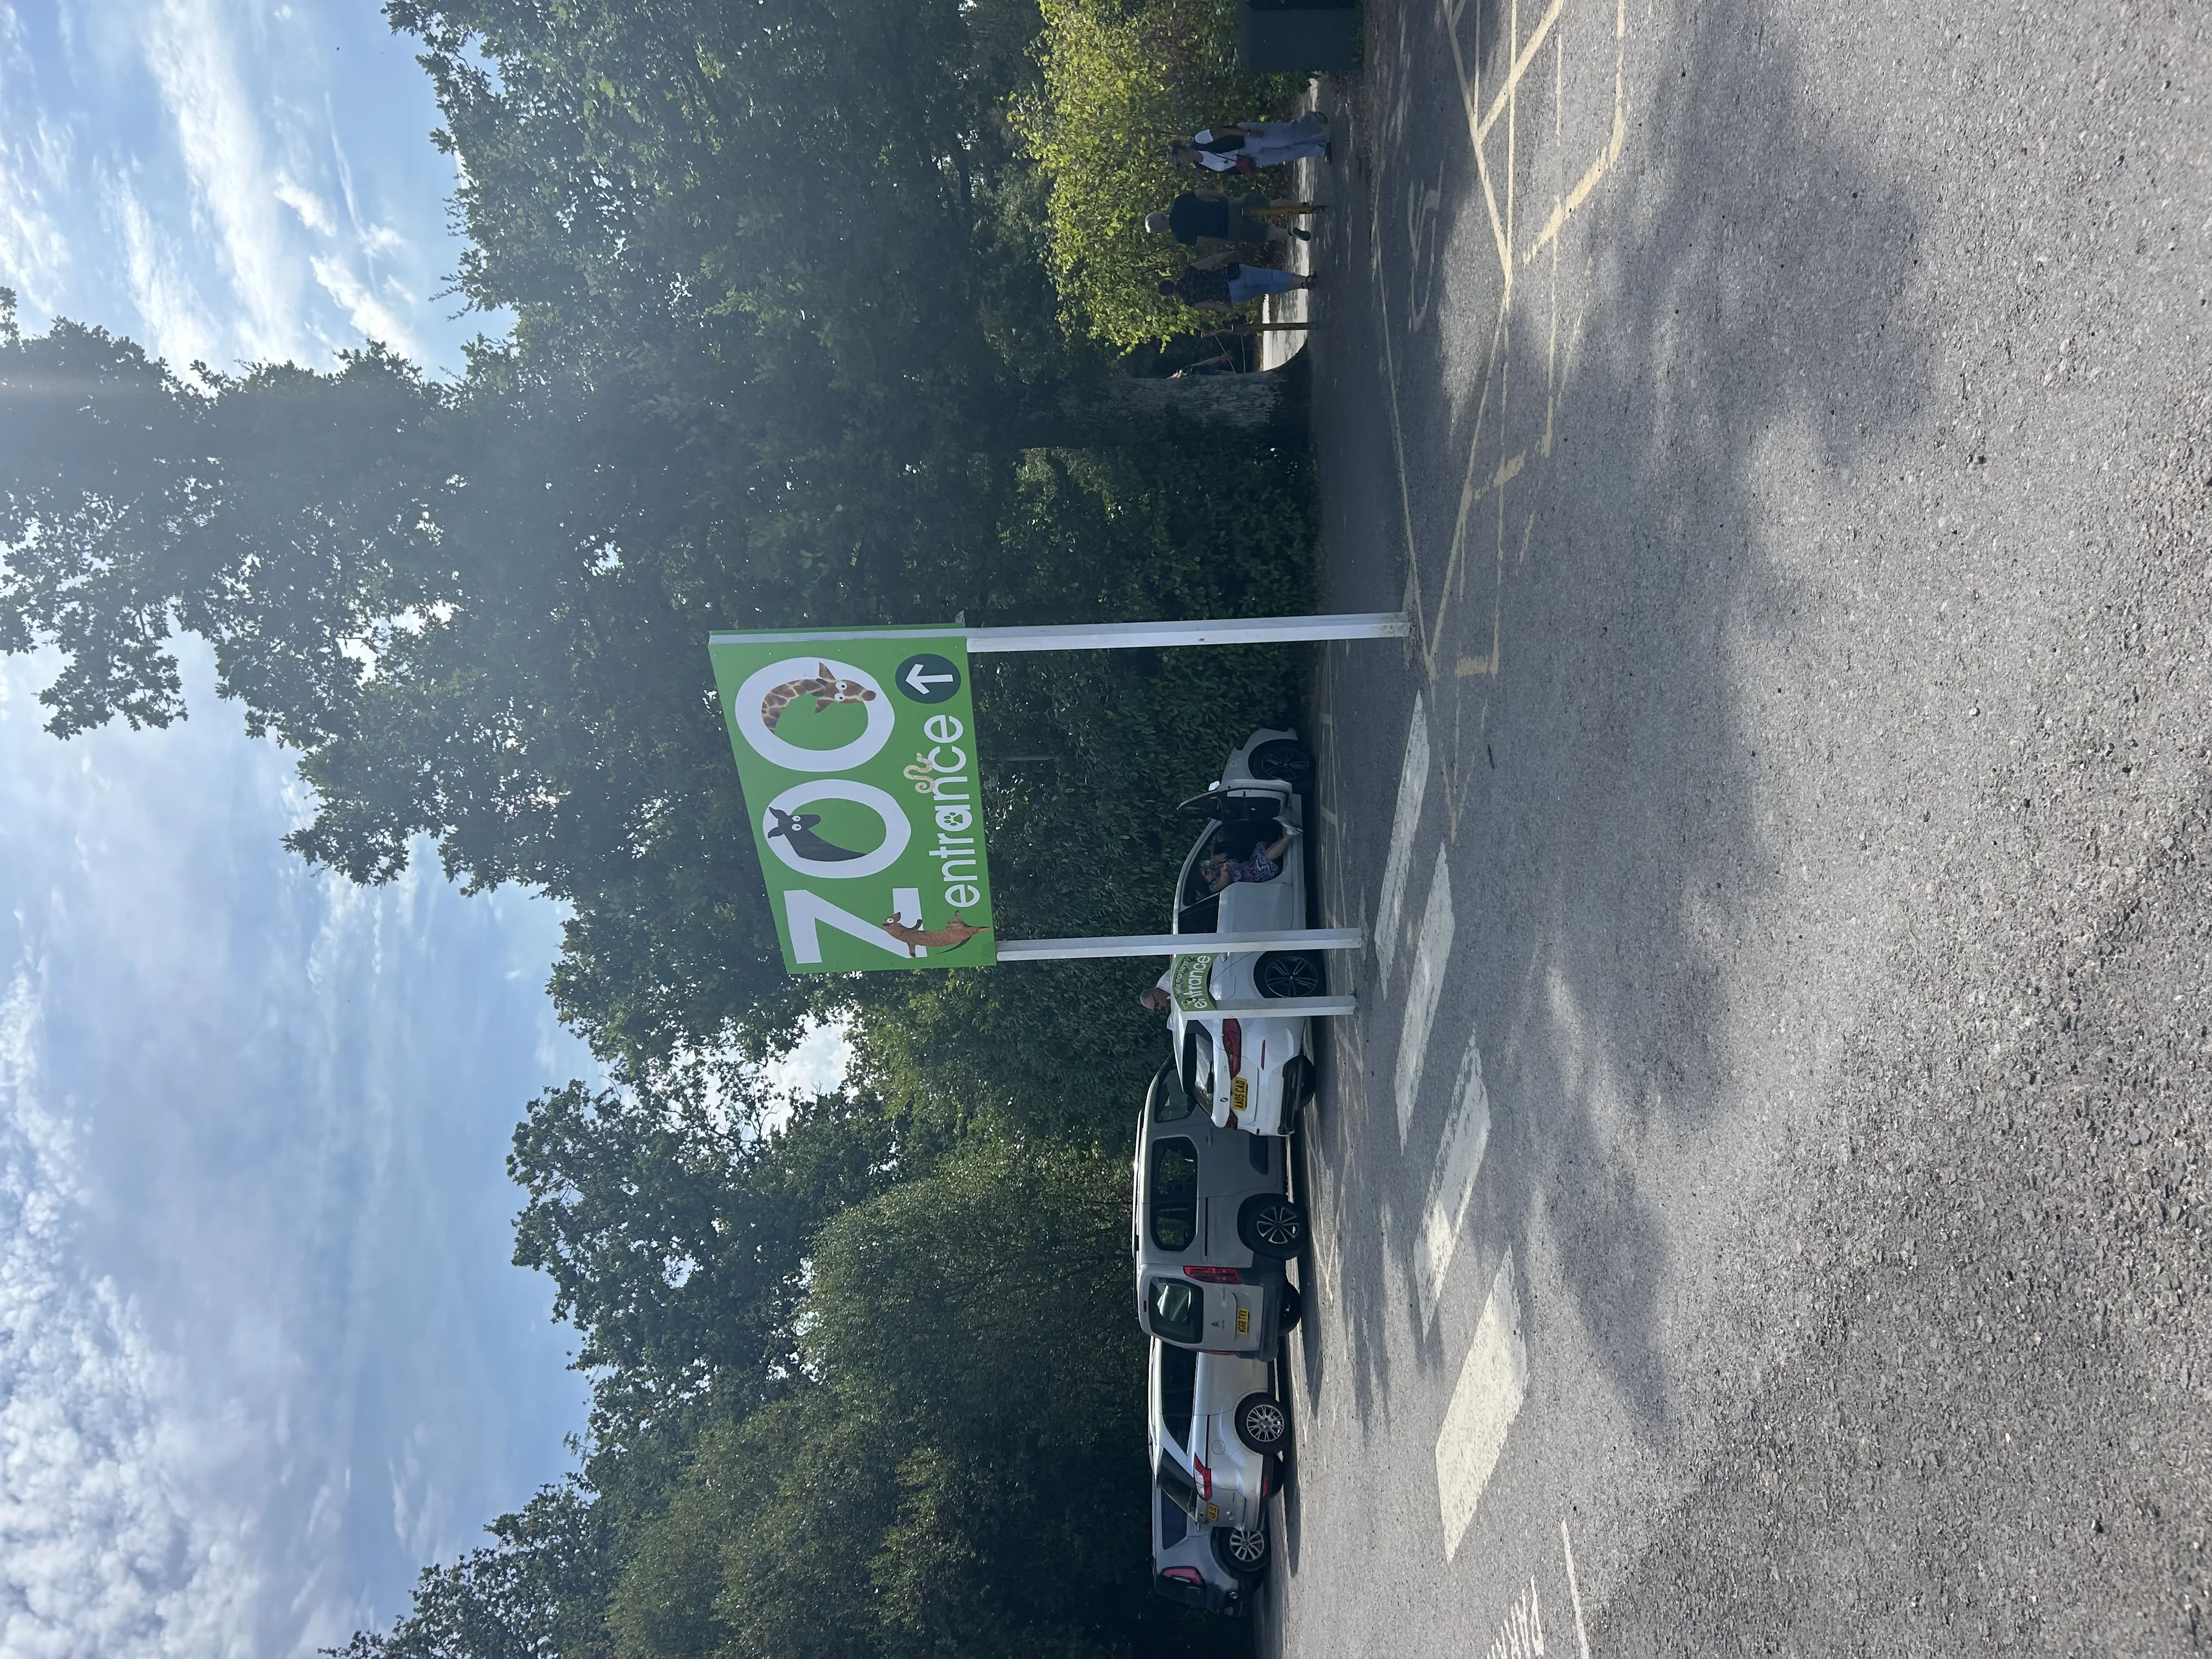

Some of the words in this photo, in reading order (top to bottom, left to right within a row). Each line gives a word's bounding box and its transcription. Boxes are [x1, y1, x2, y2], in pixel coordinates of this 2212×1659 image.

[735, 657, 927, 963] ZOO
[924, 715, 980, 907] entrance
[1183, 955, 1211, 1008] entrance
